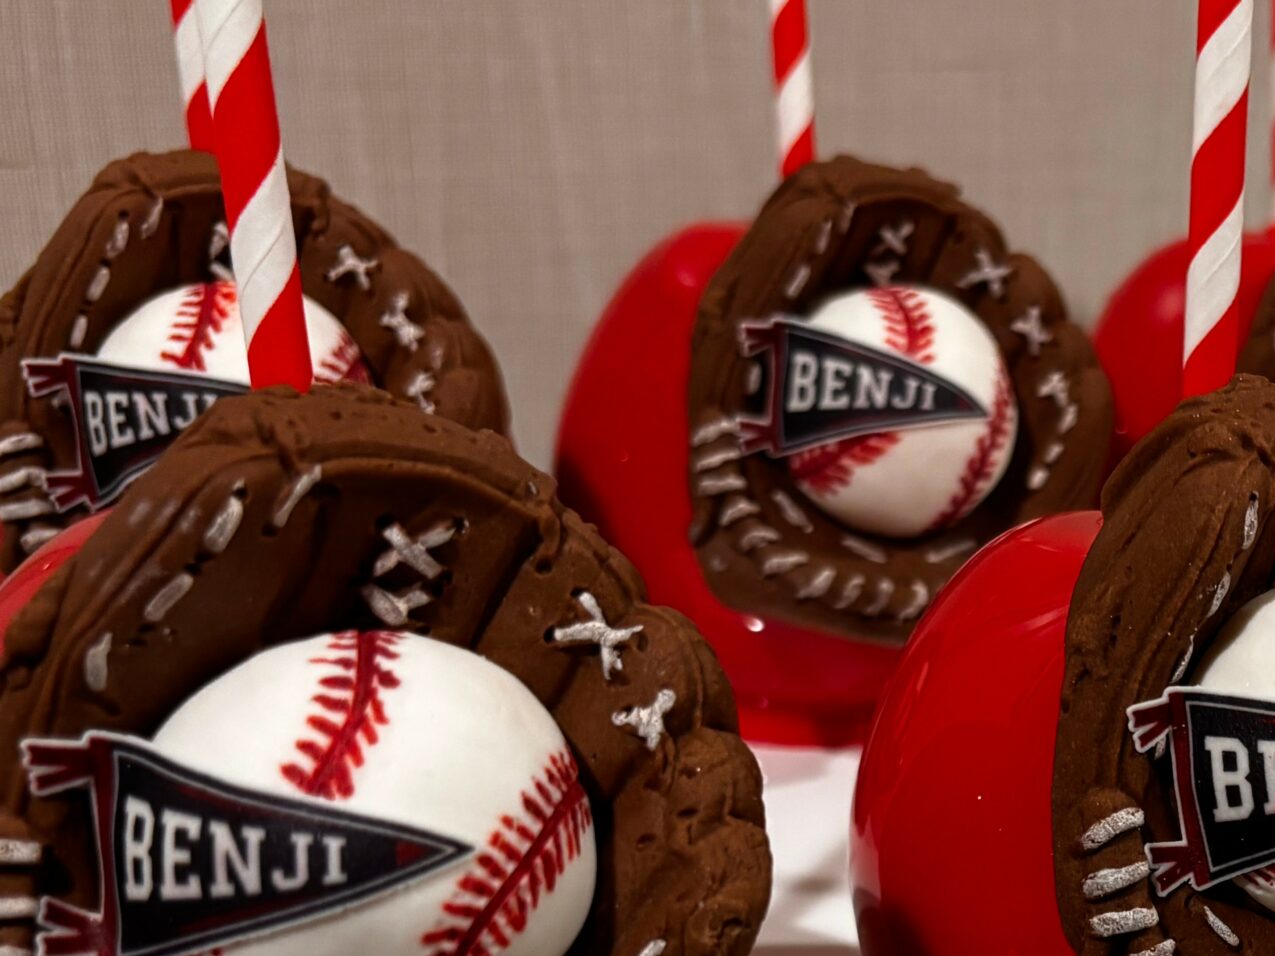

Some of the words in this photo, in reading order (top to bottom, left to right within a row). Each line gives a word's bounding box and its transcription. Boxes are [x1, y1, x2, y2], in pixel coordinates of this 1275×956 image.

[786, 352, 938, 413] BENJI
[84, 389, 218, 457] BENJ
[124, 795, 348, 901] BENJI
